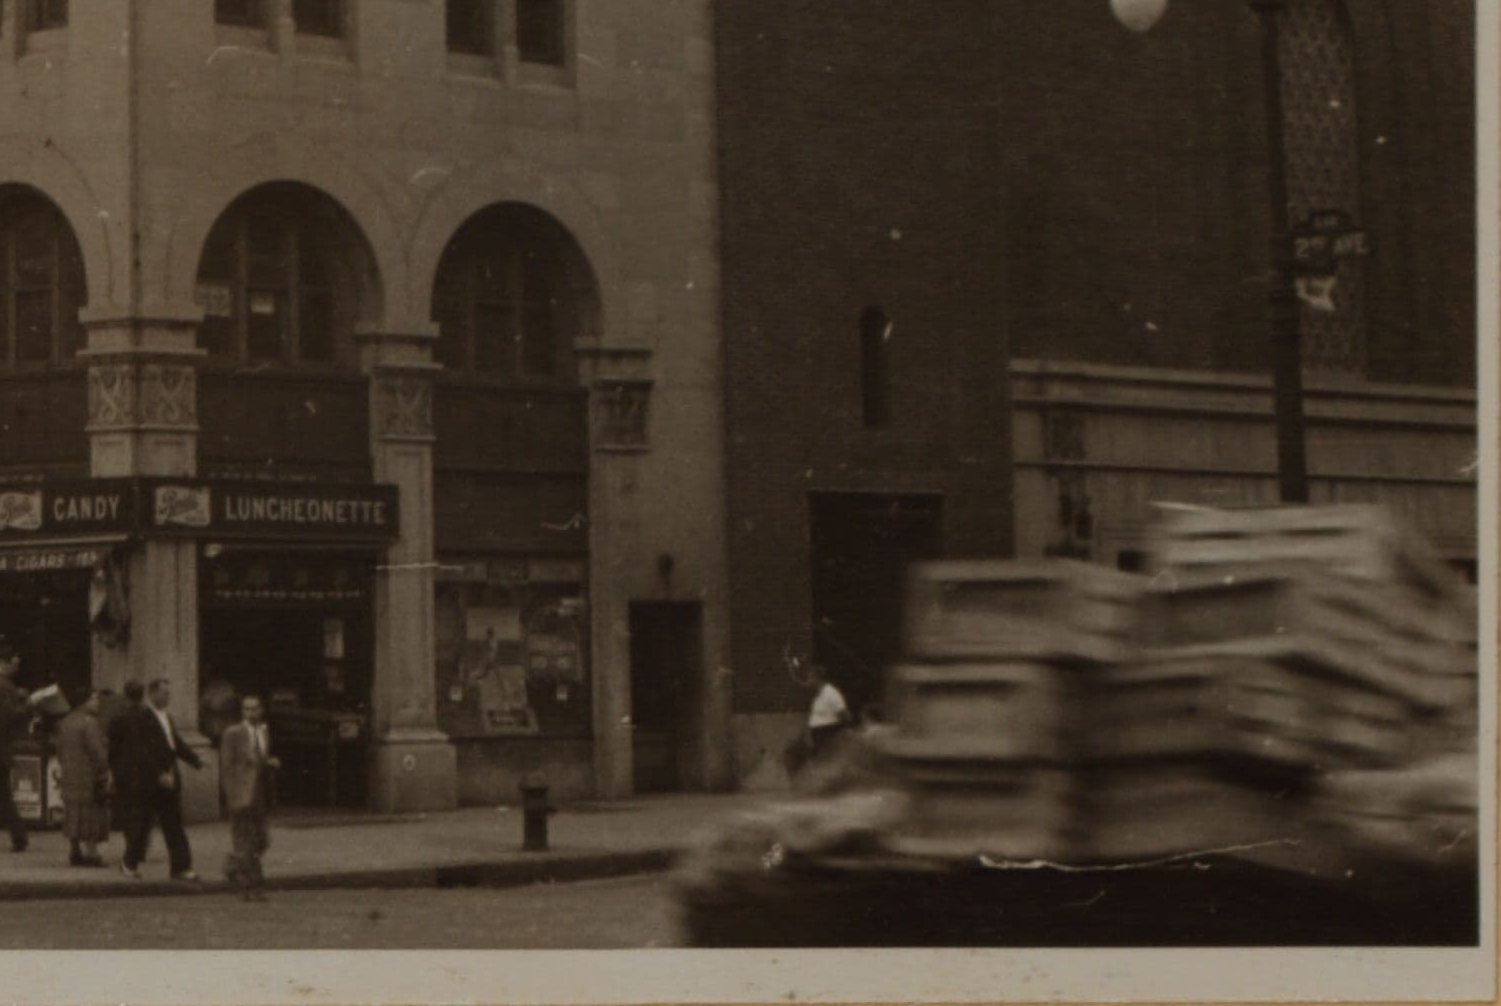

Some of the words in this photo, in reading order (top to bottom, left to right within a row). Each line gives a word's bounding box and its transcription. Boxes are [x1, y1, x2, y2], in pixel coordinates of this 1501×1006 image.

[52, 494, 120, 522] CANDY
[225, 495, 387, 526] LUNCHEONETTE
[15, 553, 65, 571] CIGARS
